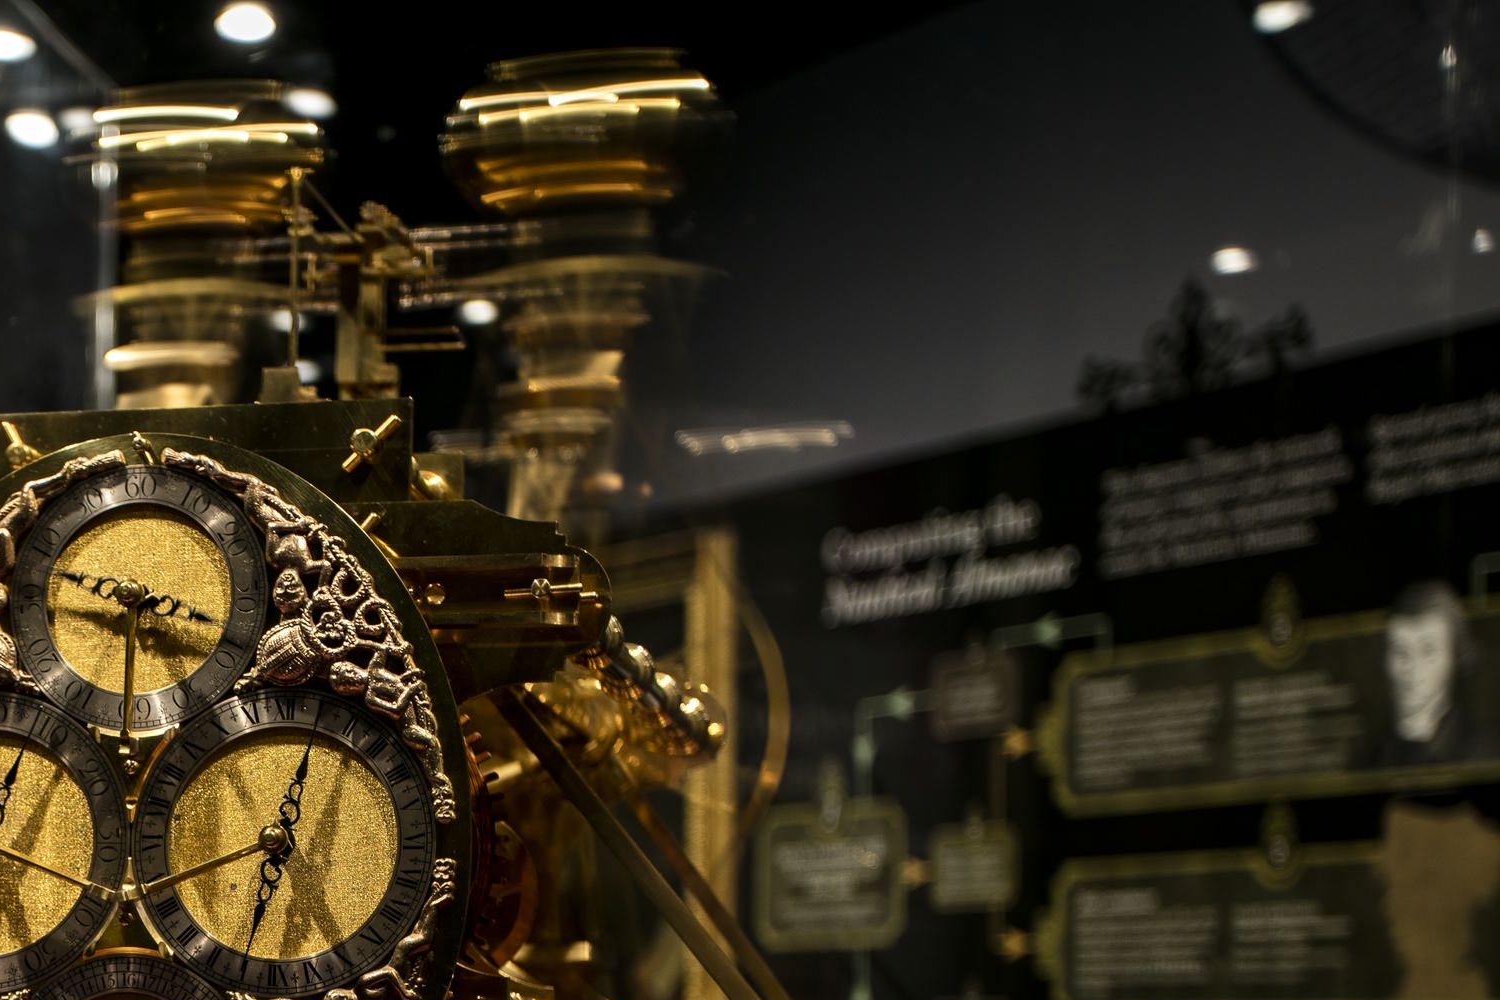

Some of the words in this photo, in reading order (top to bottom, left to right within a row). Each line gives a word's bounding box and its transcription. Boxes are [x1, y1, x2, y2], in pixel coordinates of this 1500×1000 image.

[125, 474, 157, 498] 60
[181, 485, 211, 514] 10
[217, 521, 247, 556] 20
